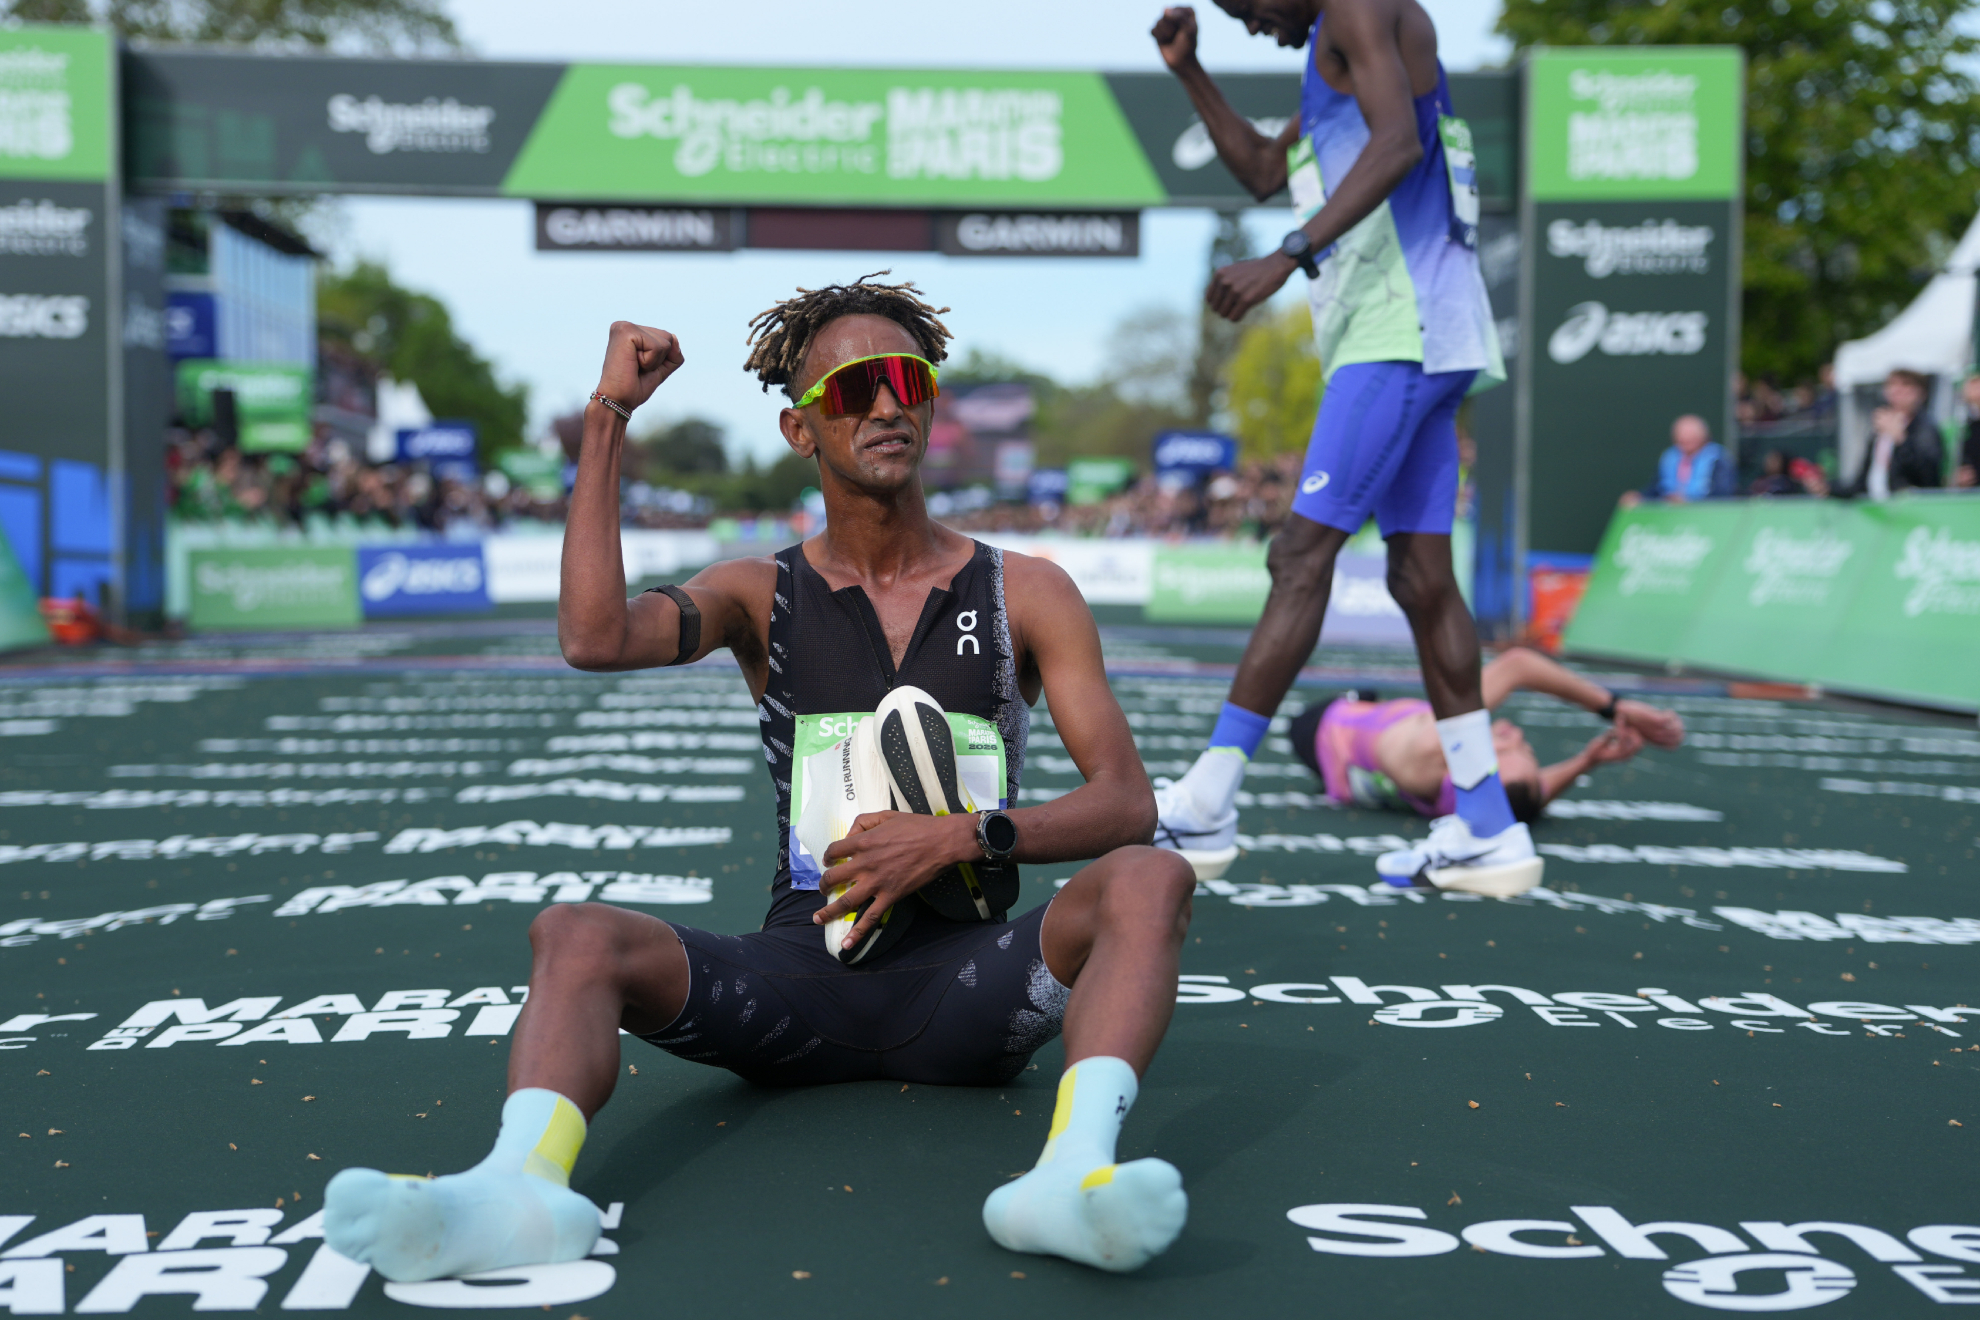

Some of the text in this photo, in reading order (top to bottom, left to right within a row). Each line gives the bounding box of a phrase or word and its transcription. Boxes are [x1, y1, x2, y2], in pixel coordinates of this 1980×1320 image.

[327, 93, 496, 134] Schneider
[608, 82, 881, 140] Schneider
[546, 207, 715, 246] GARMIN
[957, 213, 1123, 251] GARMIN
[1547, 218, 1714, 257] Schneider
[402, 557, 482, 595] asics
[819, 715, 860, 737] Sch
[845, 783, 856, 801] ON
